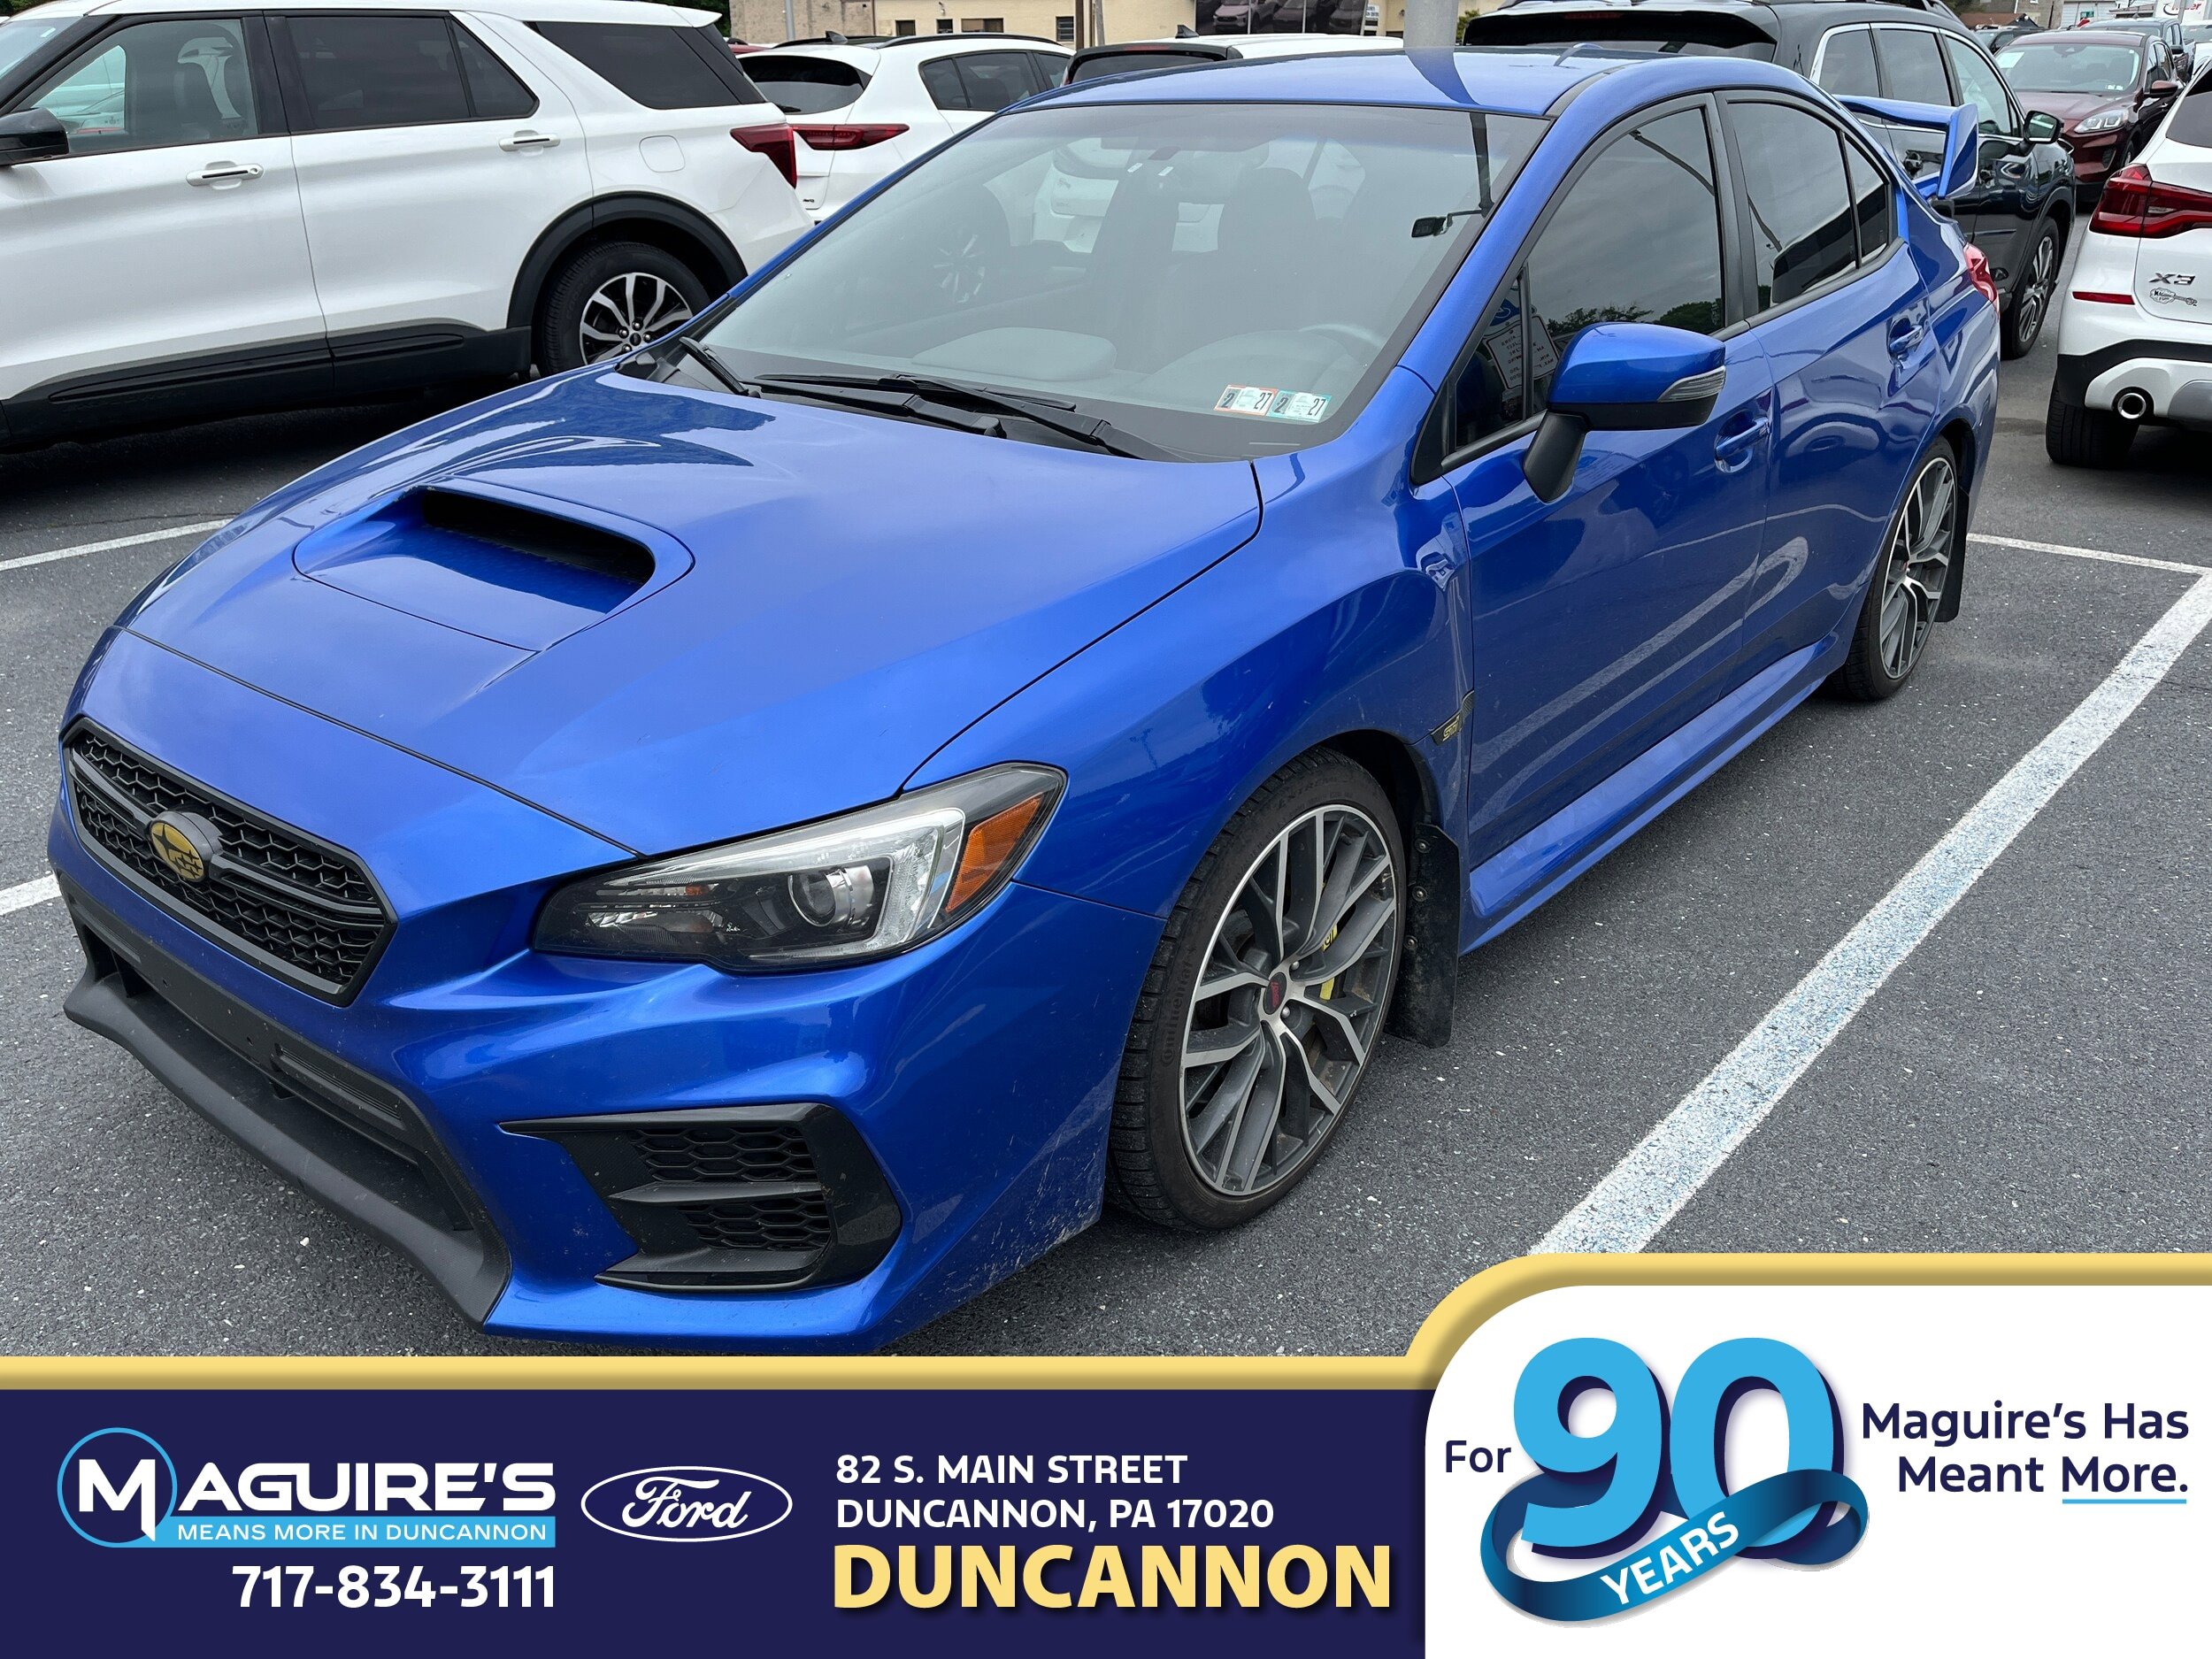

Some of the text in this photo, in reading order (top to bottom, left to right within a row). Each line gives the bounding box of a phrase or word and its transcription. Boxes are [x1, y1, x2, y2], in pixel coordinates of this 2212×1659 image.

[2148, 273, 2195, 285] X3
[1220, 392, 1272, 411] 2 27
[1273, 396, 1326, 416] 2 27
